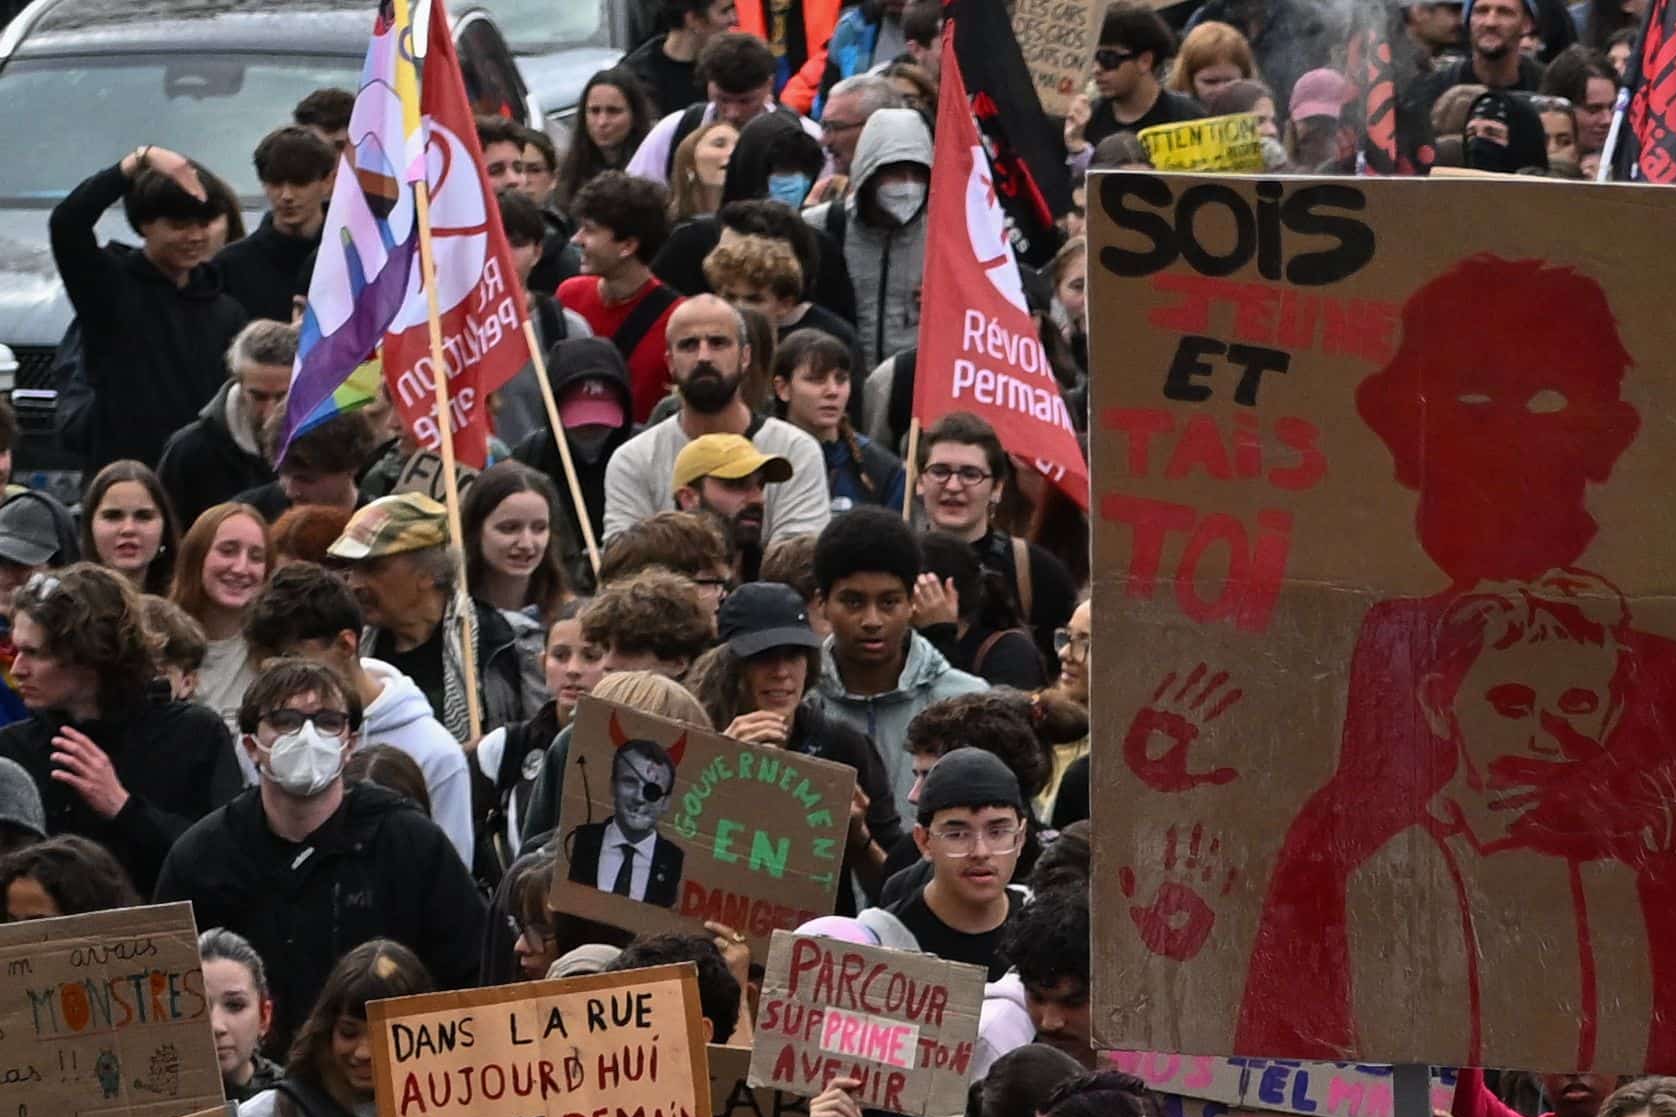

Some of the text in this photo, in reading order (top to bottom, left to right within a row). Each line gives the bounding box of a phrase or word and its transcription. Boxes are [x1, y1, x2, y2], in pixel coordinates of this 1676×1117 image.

[1163, 335, 1291, 407] ET
[673, 751, 836, 888] GOUVERNEMENT
[712, 819, 791, 880] EN
[26, 967, 209, 1036] MONSTRES
[787, 938, 949, 1027] PARCOUR
[391, 991, 653, 1064] DANS LA RUE
[760, 998, 916, 1069] SUPPRIME
